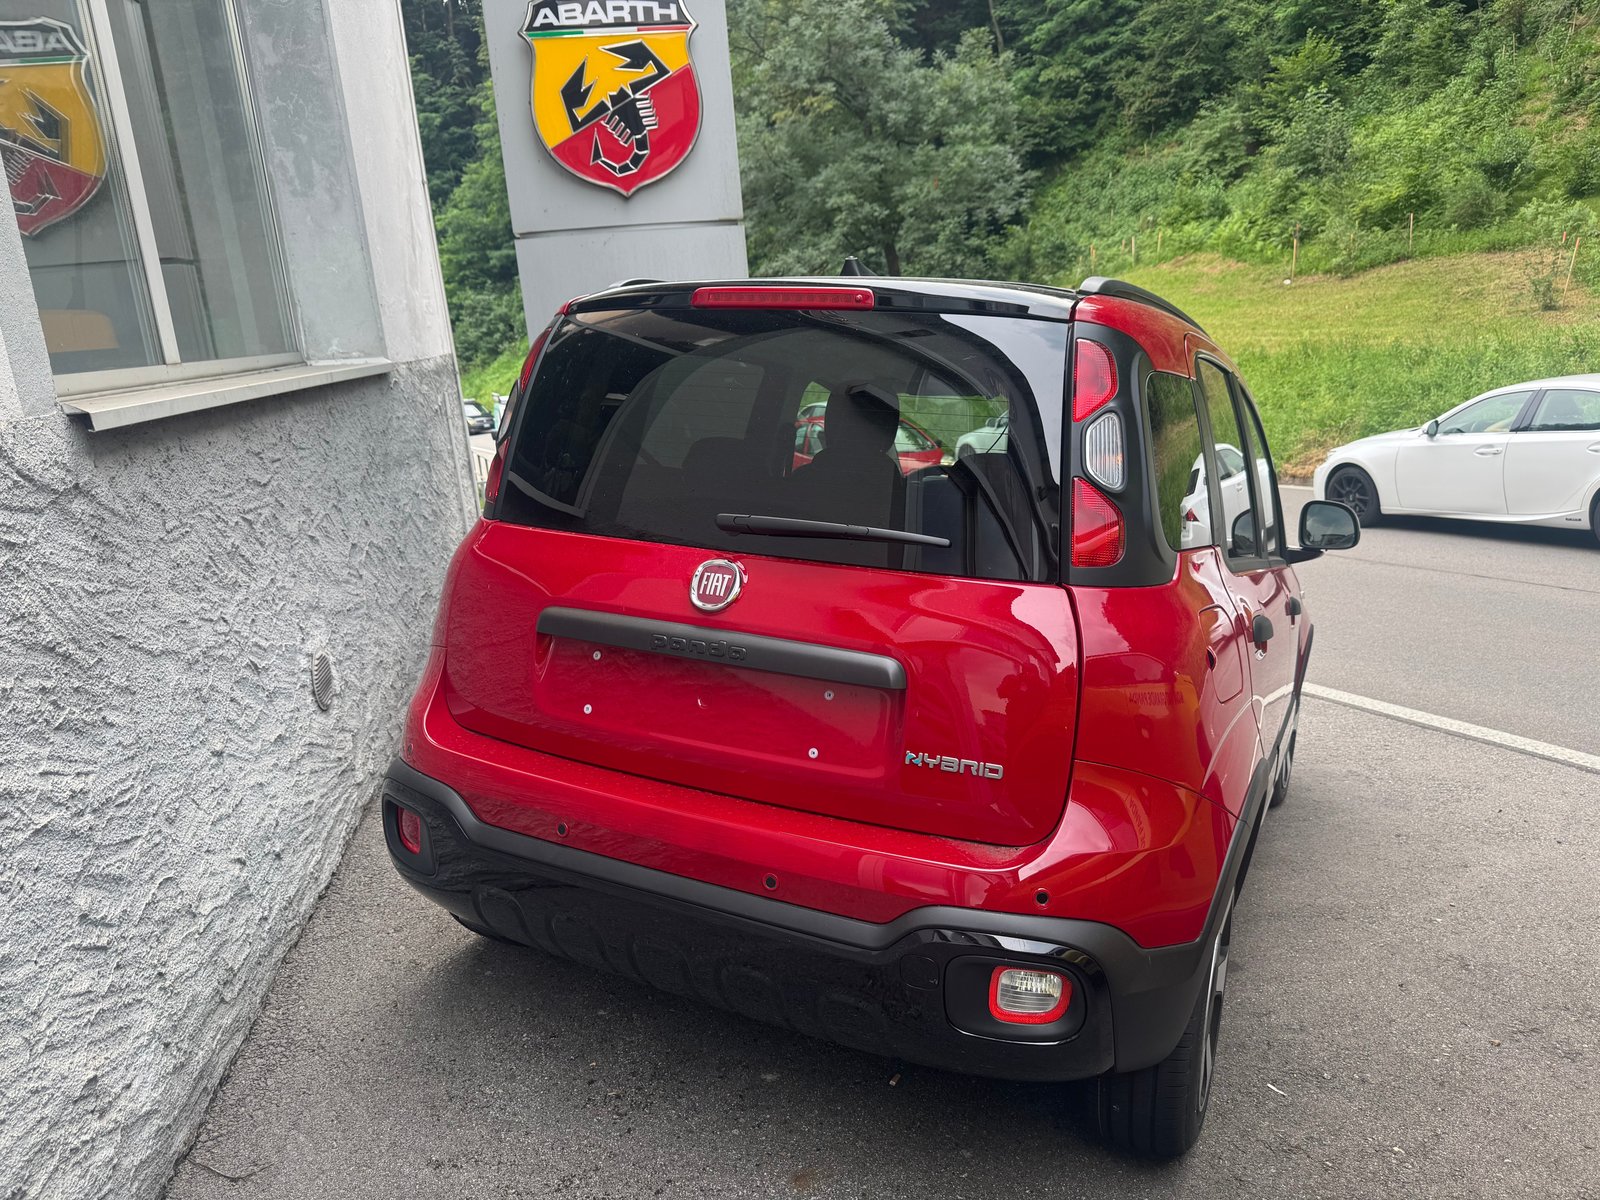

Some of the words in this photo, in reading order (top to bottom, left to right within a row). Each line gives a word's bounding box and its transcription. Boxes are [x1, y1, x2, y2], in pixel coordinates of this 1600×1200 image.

[532, 1, 677, 28] ABARTH
[699, 572, 732, 597] FIAT
[905, 750, 1004, 780] HYBRID
